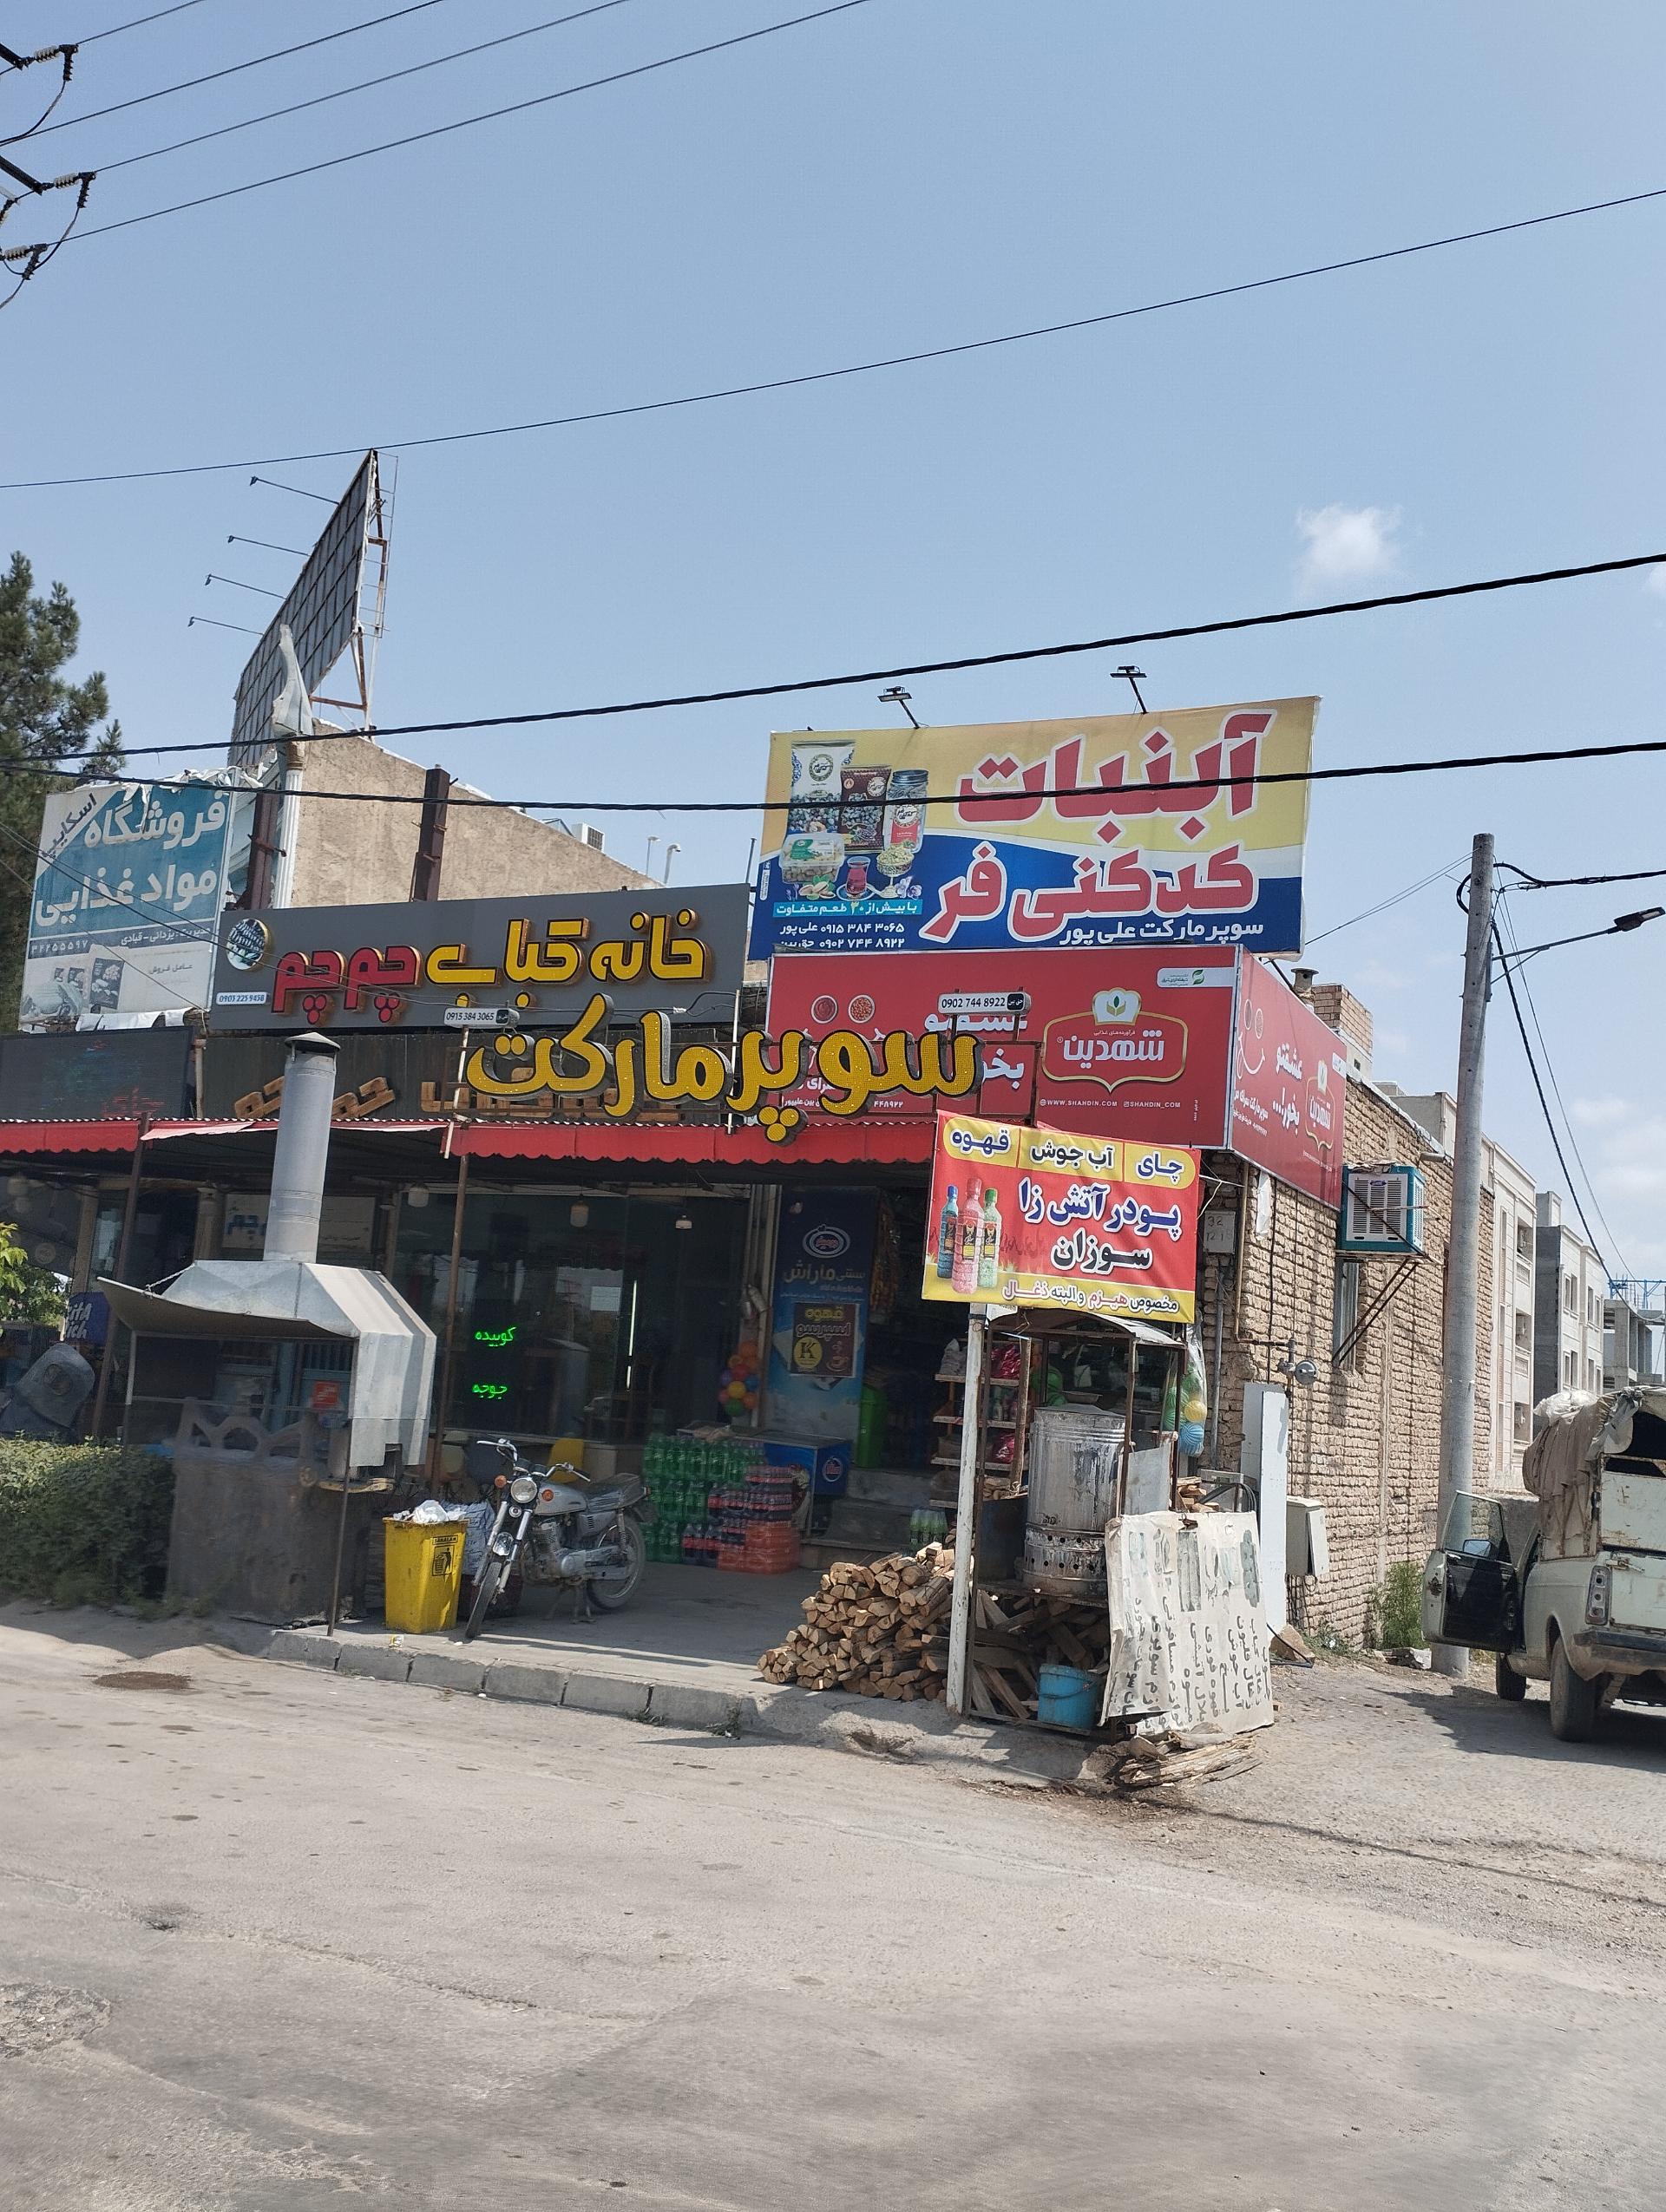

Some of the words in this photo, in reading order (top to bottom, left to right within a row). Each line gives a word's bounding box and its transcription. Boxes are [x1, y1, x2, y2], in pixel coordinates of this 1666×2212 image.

[956, 709, 1278, 845] آبنبات
[84, 789, 226, 850] فروشگاه
[36, 867, 134, 926] غذایی
[141, 864, 217, 912] مواد
[919, 841, 1007, 944] فر
[1009, 841, 1259, 942] کدکنی
[777, 903, 819, 916] متفاوت
[819, 902, 847, 916] طعم
[588, 907, 705, 984] خانه
[941, 998, 963, 1009] 0902
[965, 998, 982, 1009] 744
[983, 997, 1006, 1008] 8922
[1063, 1030, 1164, 1069] شهدین
[952, 1129, 1009, 1155] قهوه
[1031, 1141, 1085, 1168] جوش
[1088, 1146, 1114, 1169] آب
[1137, 1154, 1183, 1182] چای
[1106, 1198, 1179, 1239] پودر
[1053, 1229, 1150, 1273] سوزان
[1004, 1279, 1048, 1299] ذغال
[1088, 1289, 1127, 1309] هیزم
[1130, 1293, 1178, 1313] مخصوص
